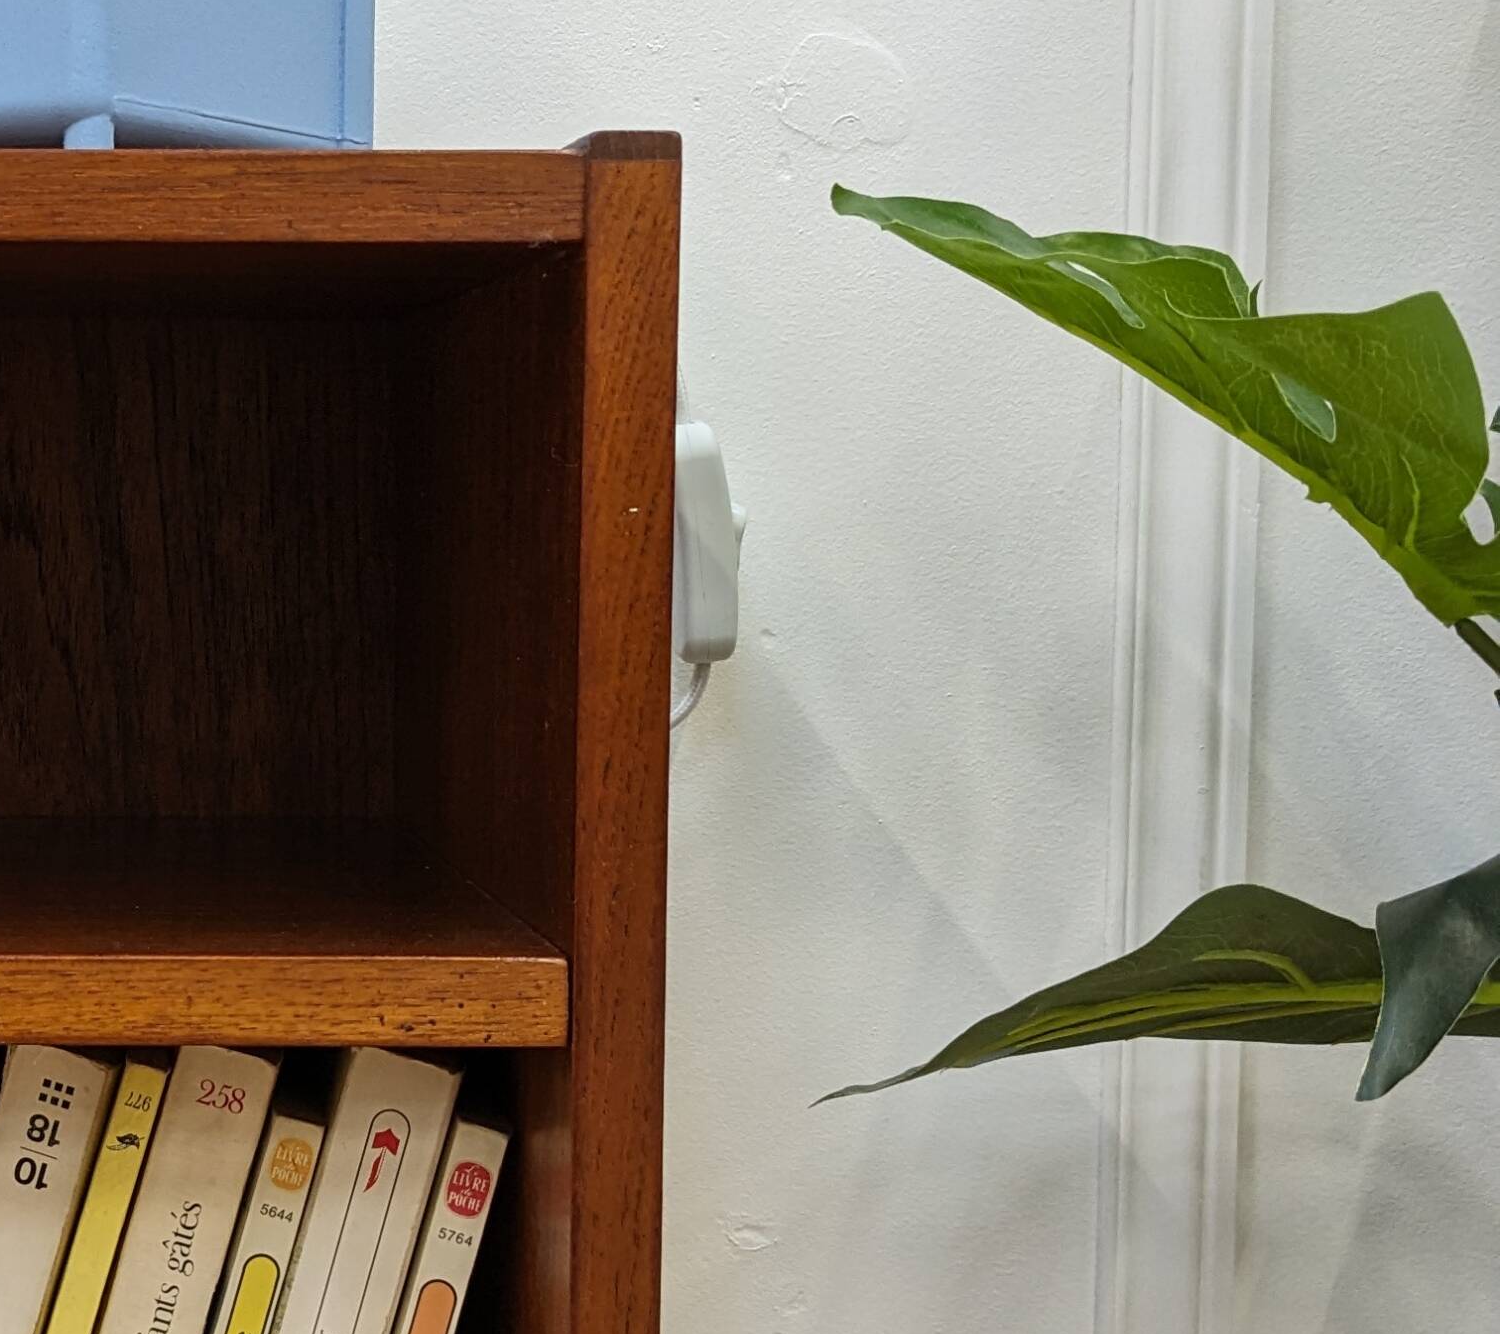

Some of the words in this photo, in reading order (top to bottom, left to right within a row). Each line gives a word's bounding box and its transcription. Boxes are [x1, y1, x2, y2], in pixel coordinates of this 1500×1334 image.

[124, 1091, 153, 1113] 977
[195, 1079, 245, 1114] 258
[26, 1114, 60, 1147] 18
[14, 1157, 48, 1190] 10
[452, 1170, 489, 1192] LIVRE
[260, 1203, 294, 1223] 5644
[447, 1191, 481, 1213] POCHE
[162, 1200, 202, 1276] gâtés
[438, 1227, 473, 1247] 5764
